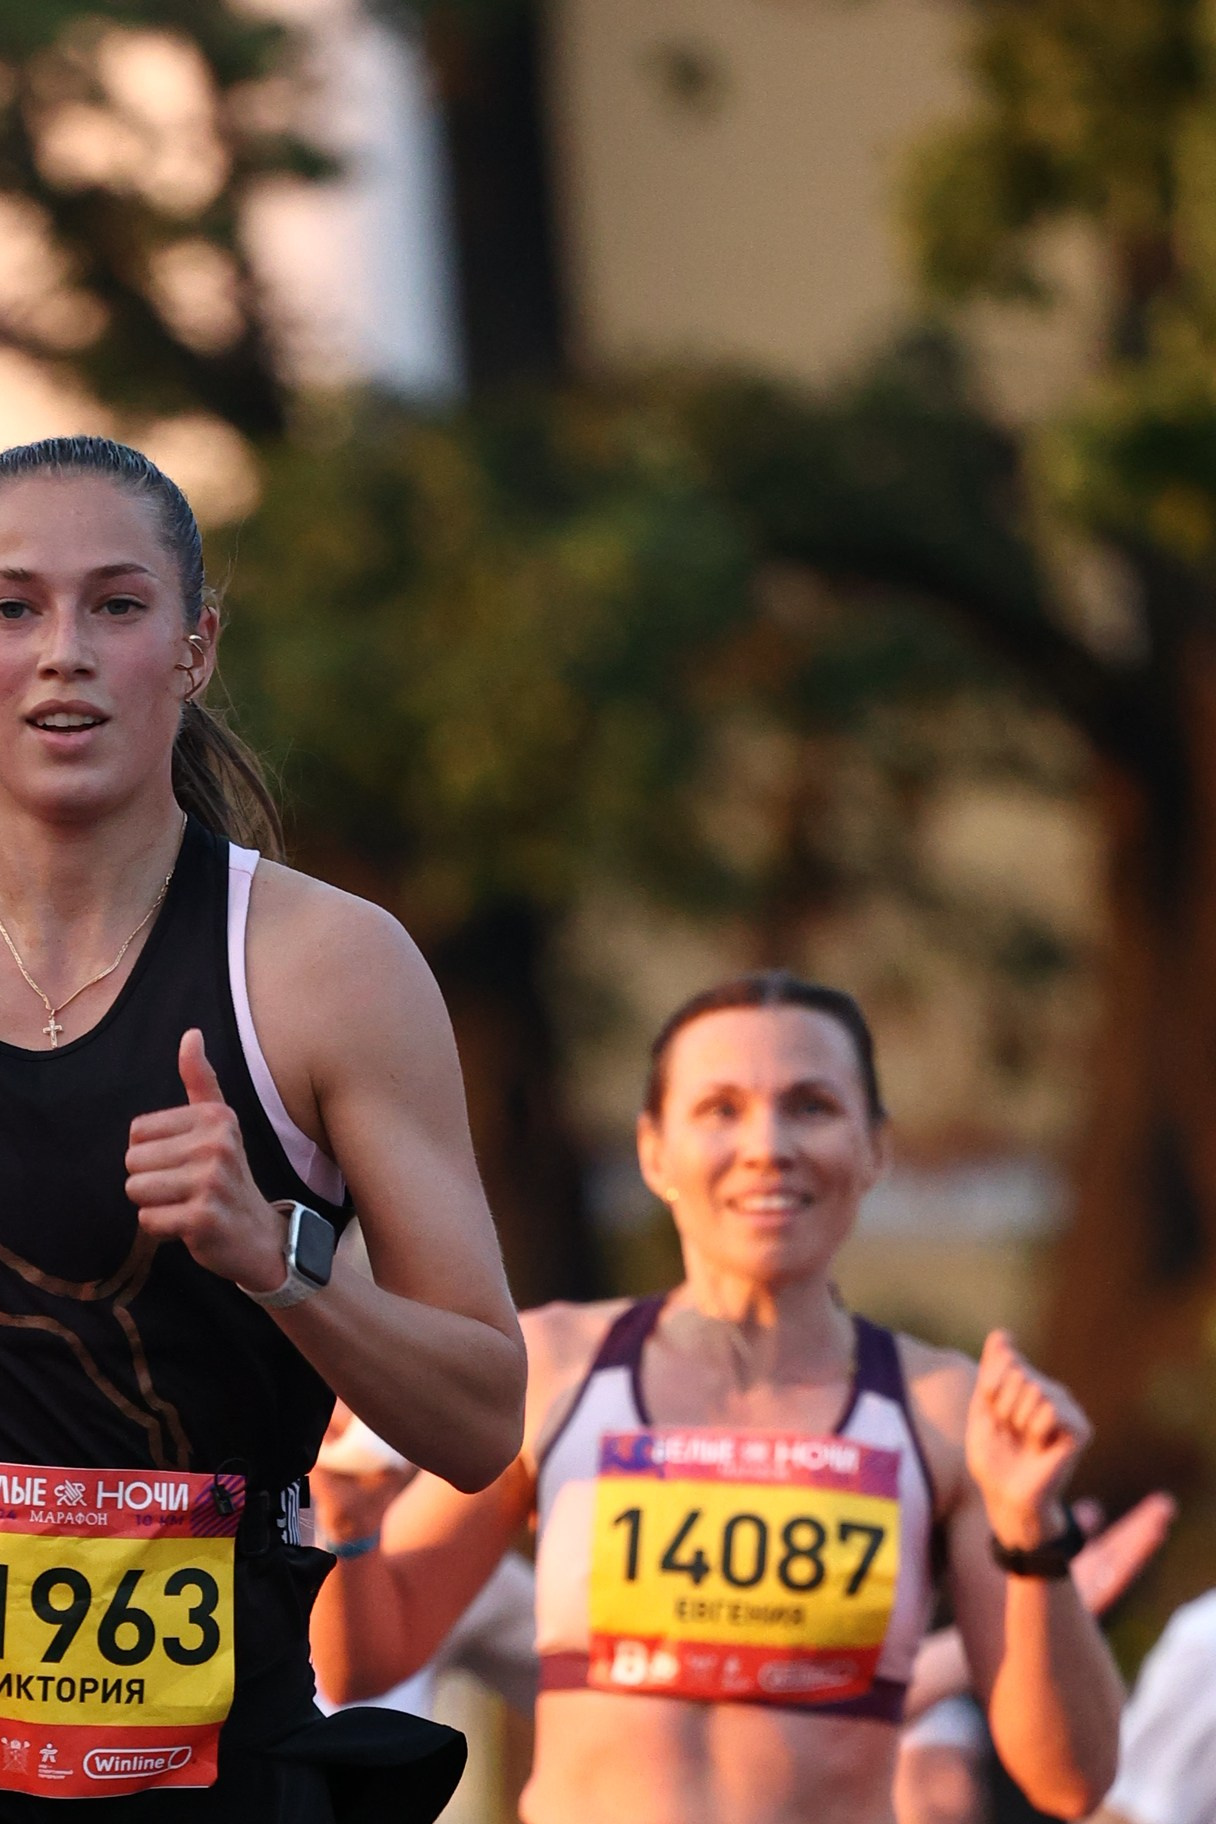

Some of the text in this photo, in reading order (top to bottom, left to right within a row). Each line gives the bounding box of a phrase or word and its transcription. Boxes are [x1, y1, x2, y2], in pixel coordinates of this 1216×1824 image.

[96, 1481, 189, 1511] НОЧИ
[29, 1510, 108, 1526] МАРАФОН
[611, 1507, 885, 1596] 14087
[94, 1756, 165, 1772] Winline
